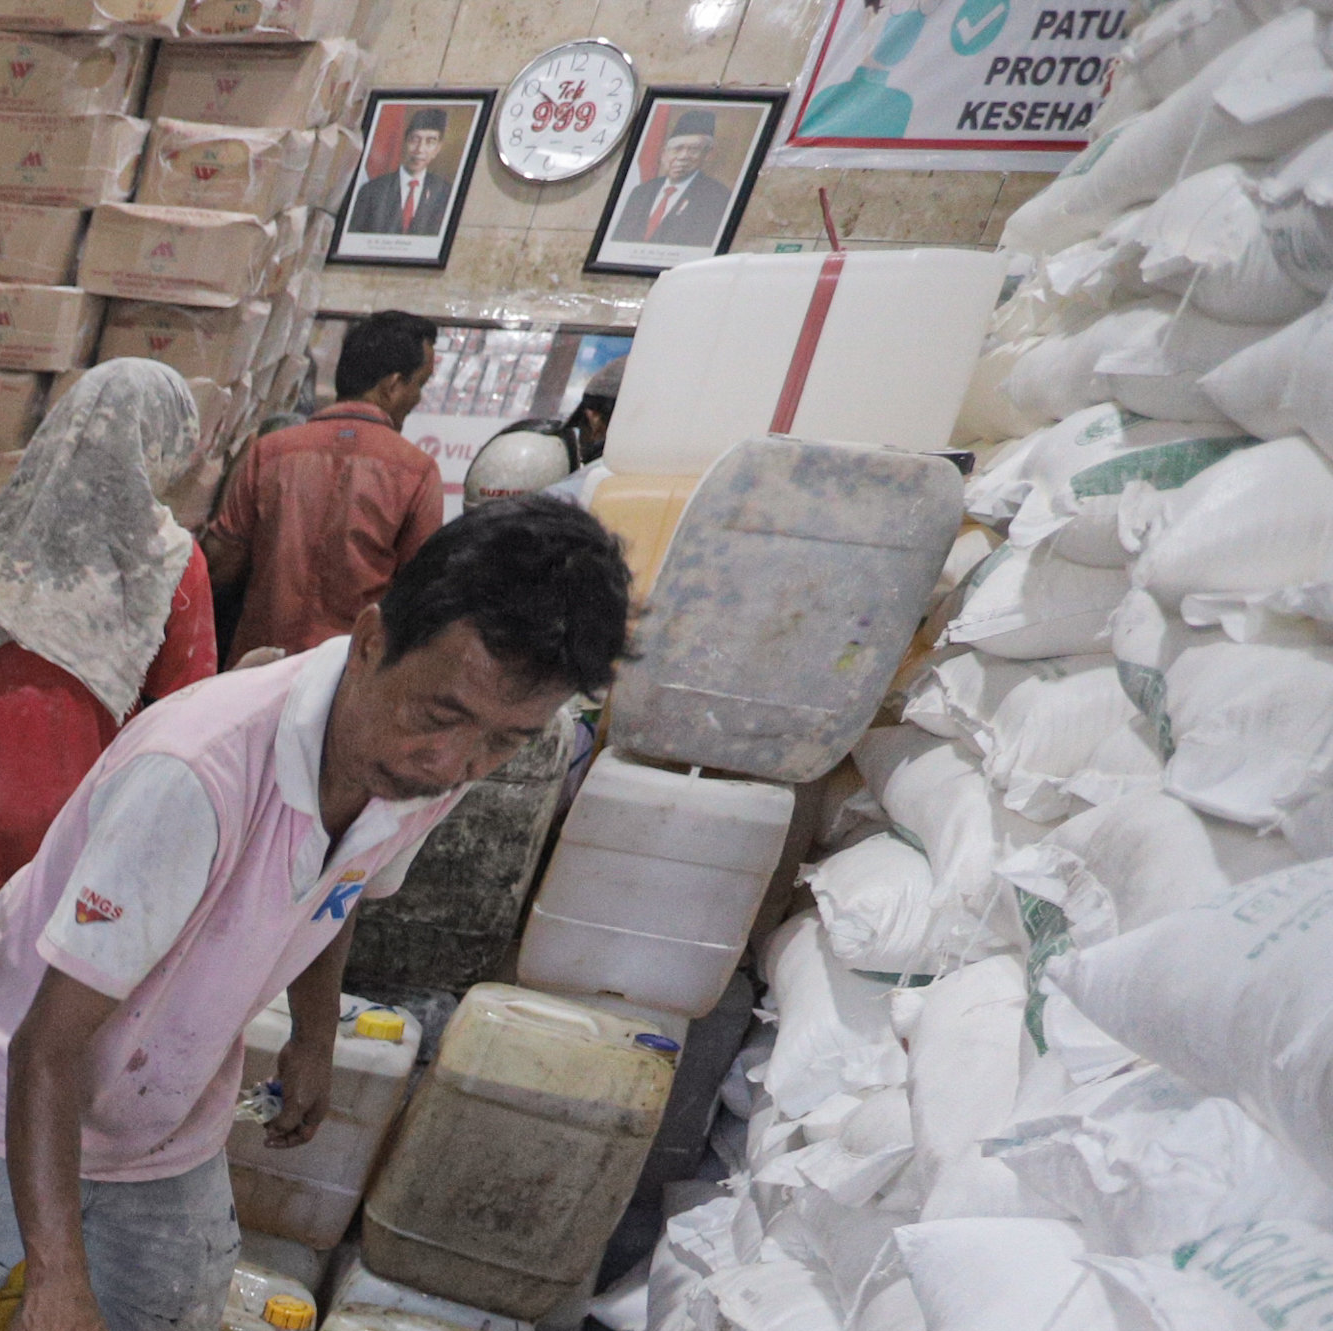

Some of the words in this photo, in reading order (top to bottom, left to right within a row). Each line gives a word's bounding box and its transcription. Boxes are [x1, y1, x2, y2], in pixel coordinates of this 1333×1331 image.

[1031, 10, 1128, 41] PATU
[546, 60, 561, 79] 11
[570, 51, 590, 72] 12
[521, 79, 541, 98] 10
[607, 78, 623, 97] 2
[510, 103, 523, 121] 9
[531, 101, 596, 132] 999
[606, 103, 622, 122] 3
[956, 101, 1104, 131] KESEHA
[509, 128, 523, 146] 8
[591, 128, 606, 146] 4
[523, 146, 537, 164] 7
